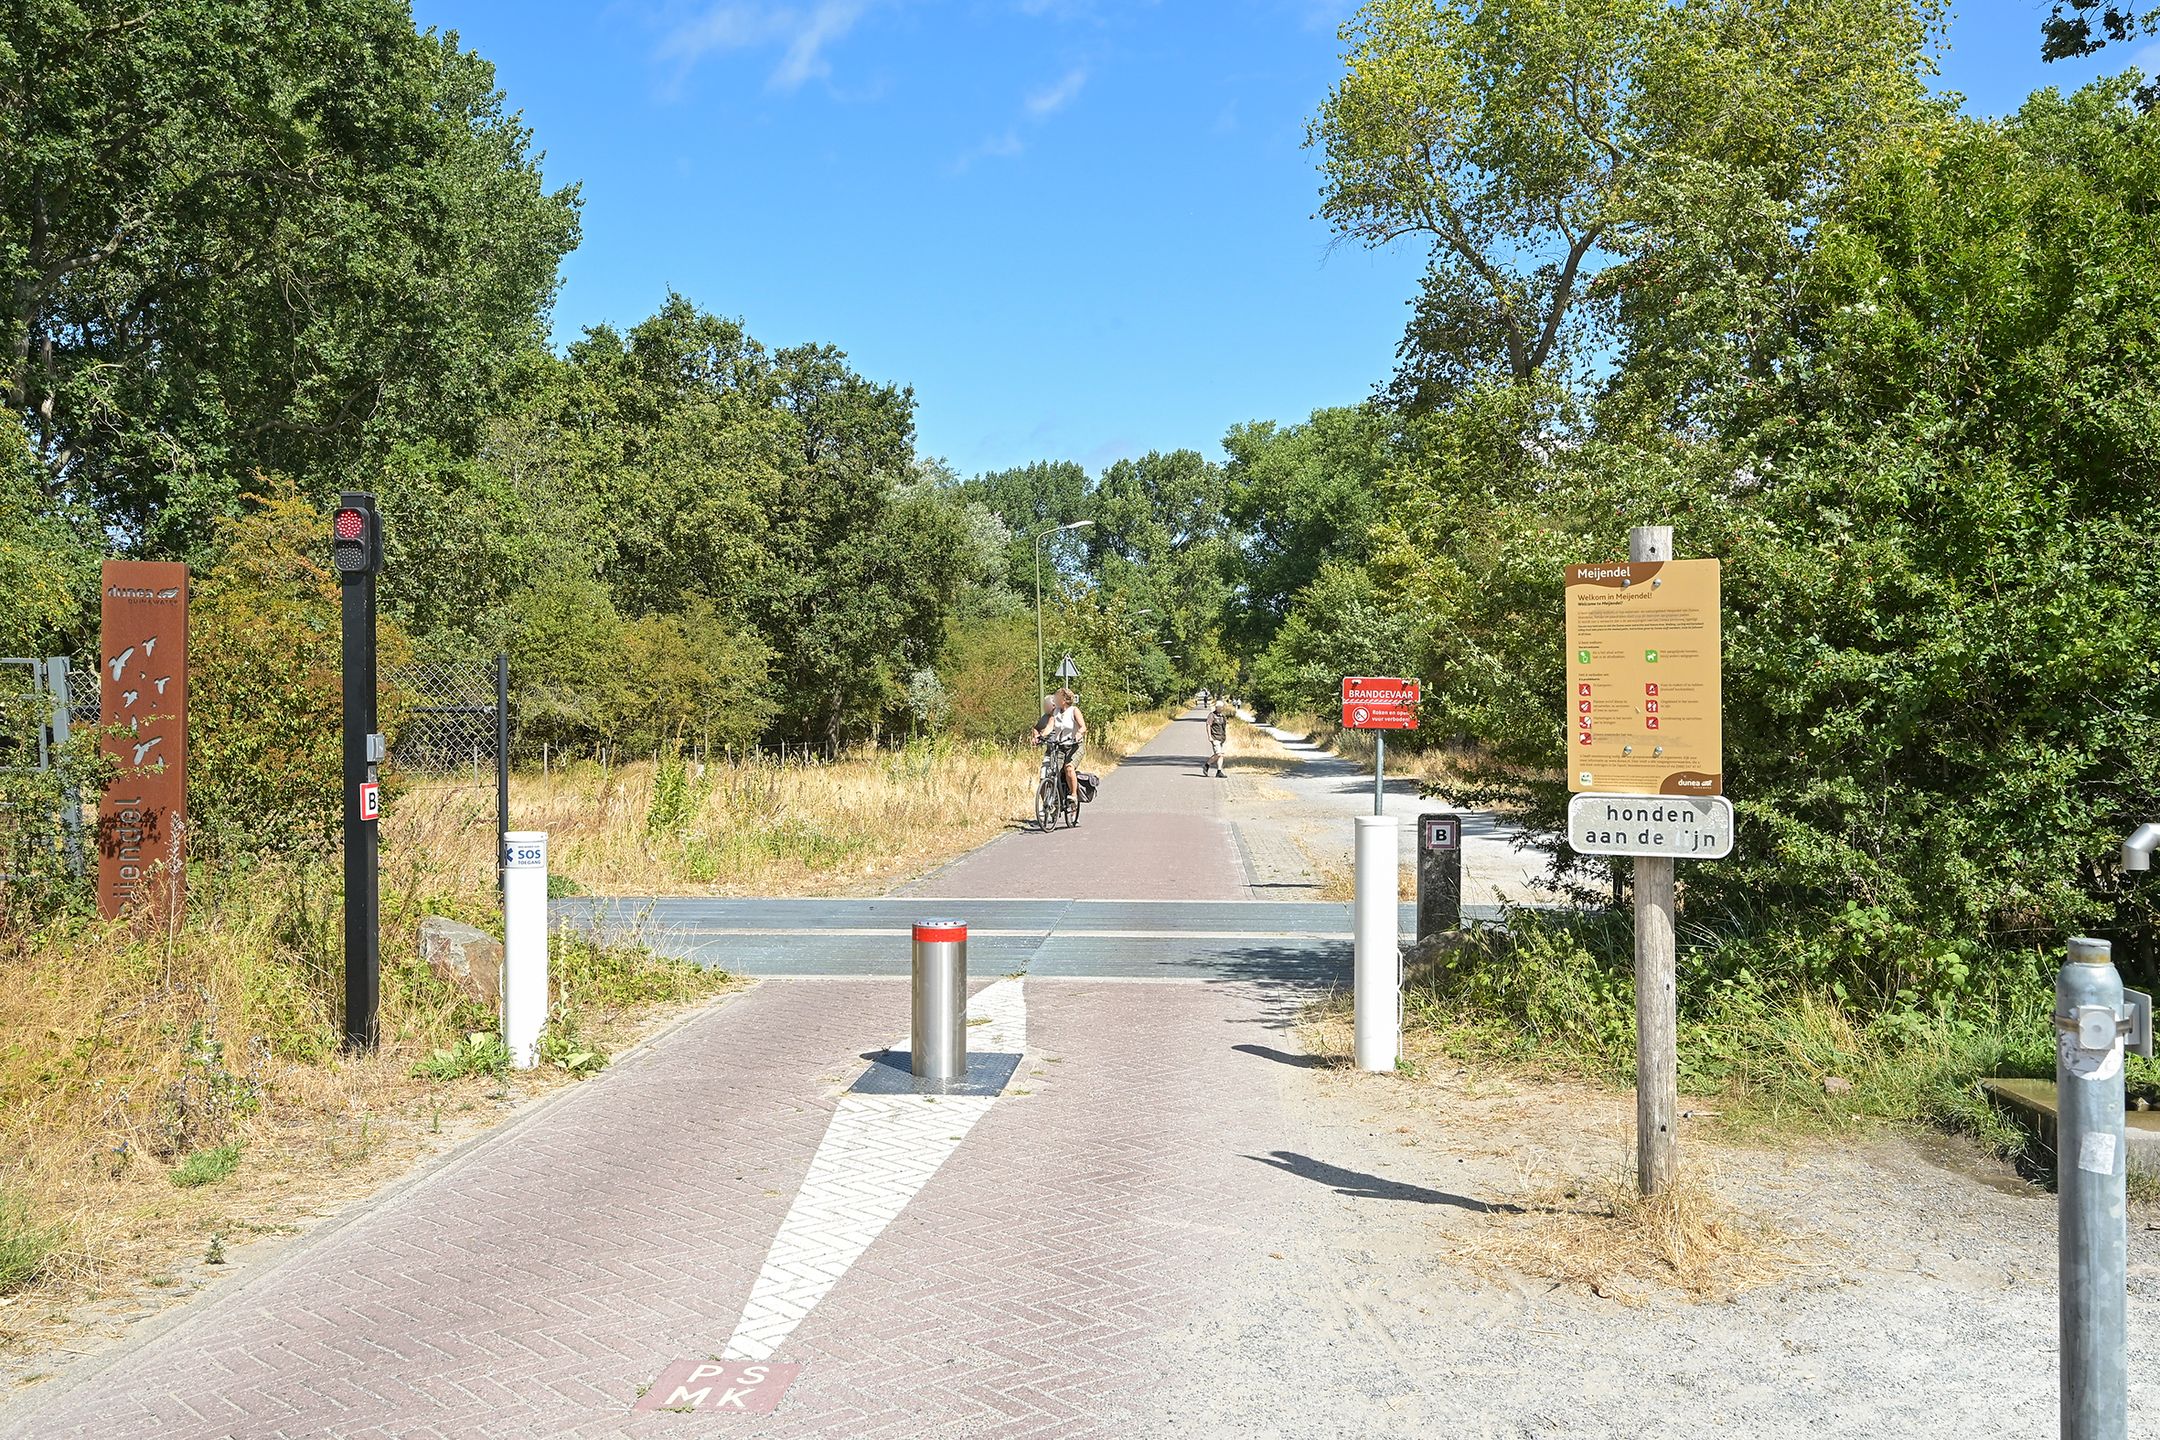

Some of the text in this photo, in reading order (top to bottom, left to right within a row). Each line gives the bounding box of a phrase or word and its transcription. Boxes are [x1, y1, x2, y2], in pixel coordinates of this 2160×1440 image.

[1577, 567, 1631, 580] Meijendel
[107, 584, 154, 598] dunea
[1577, 592, 1653, 602] Welkom in Meijendel!
[1348, 690, 1414, 699] BRANDGEVAAR
[368, 792, 376, 811] B
[1607, 805, 1694, 823] honden
[1435, 829, 1448, 842] B
[1585, 830, 1628, 844] aan
[1638, 829, 1664, 845] de
[518, 849, 541, 860] SOS
